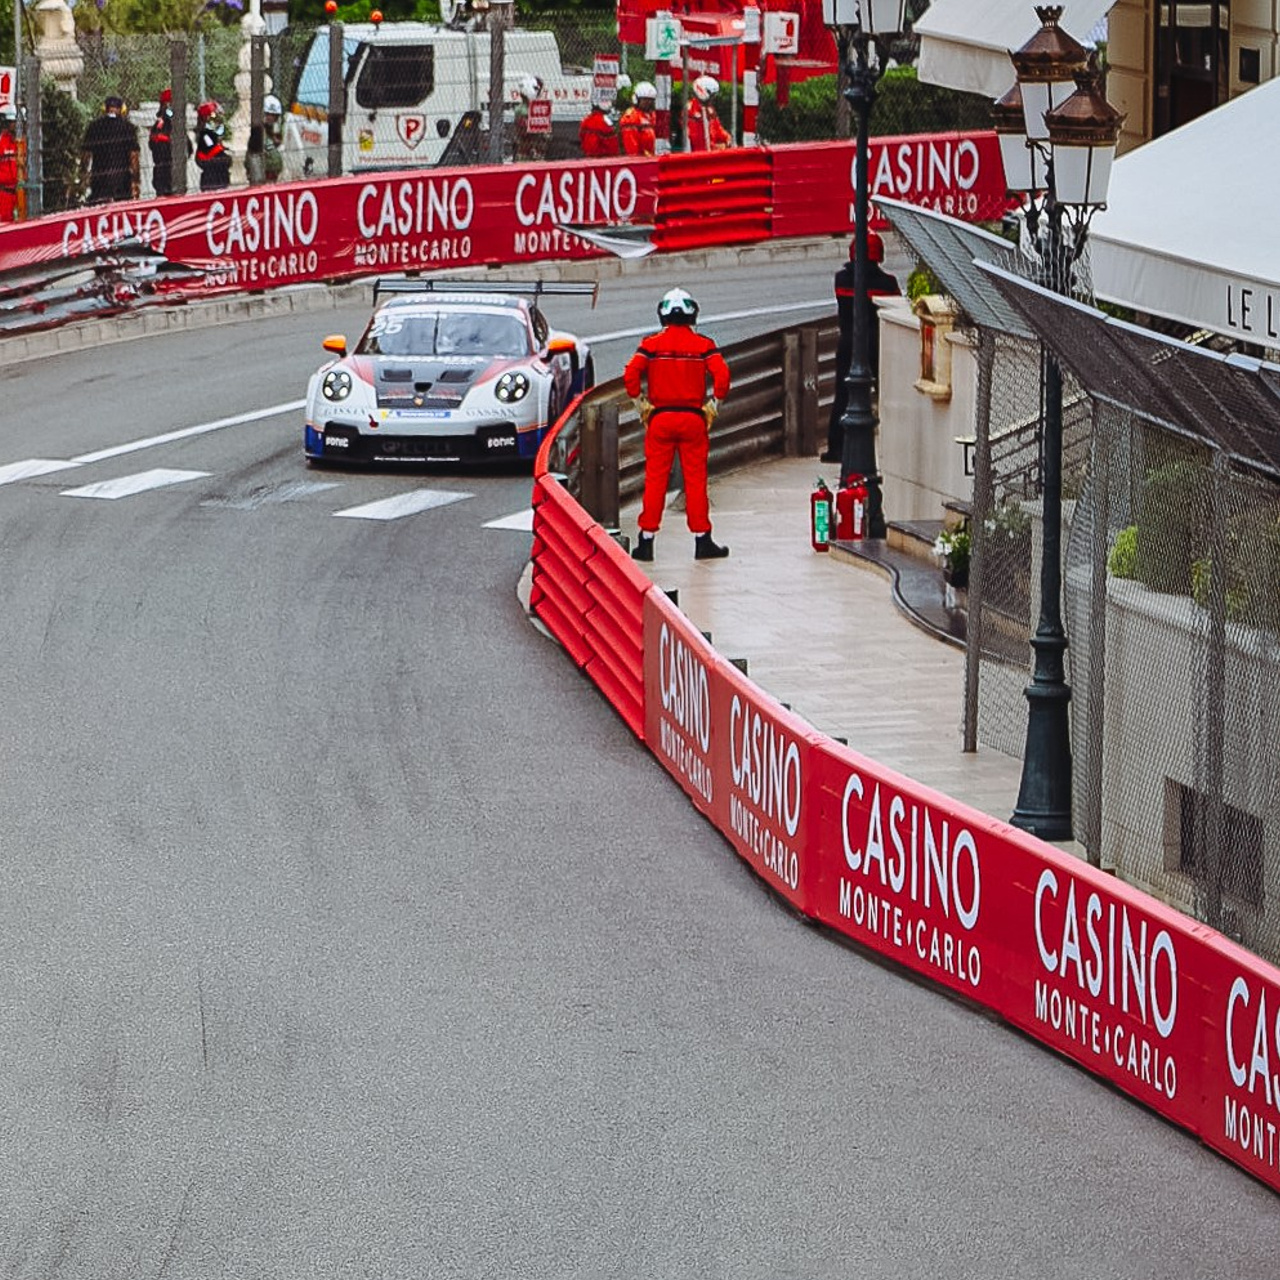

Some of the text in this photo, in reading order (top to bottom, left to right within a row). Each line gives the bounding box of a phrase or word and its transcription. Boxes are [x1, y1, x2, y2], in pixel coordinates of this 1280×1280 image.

[206, 190, 318, 256] CASINO
[357, 177, 474, 239] CASINO
[514, 167, 637, 227] CASINO
[369, 317, 405, 338] 25
[1227, 284, 1278, 338] LE L
[659, 623, 710, 753] CASINO
[730, 694, 801, 837] CASINO
[841, 773, 981, 930] CASINO
[1035, 868, 1178, 1038] CASINO
[1226, 1095, 1280, 1172] MONT
